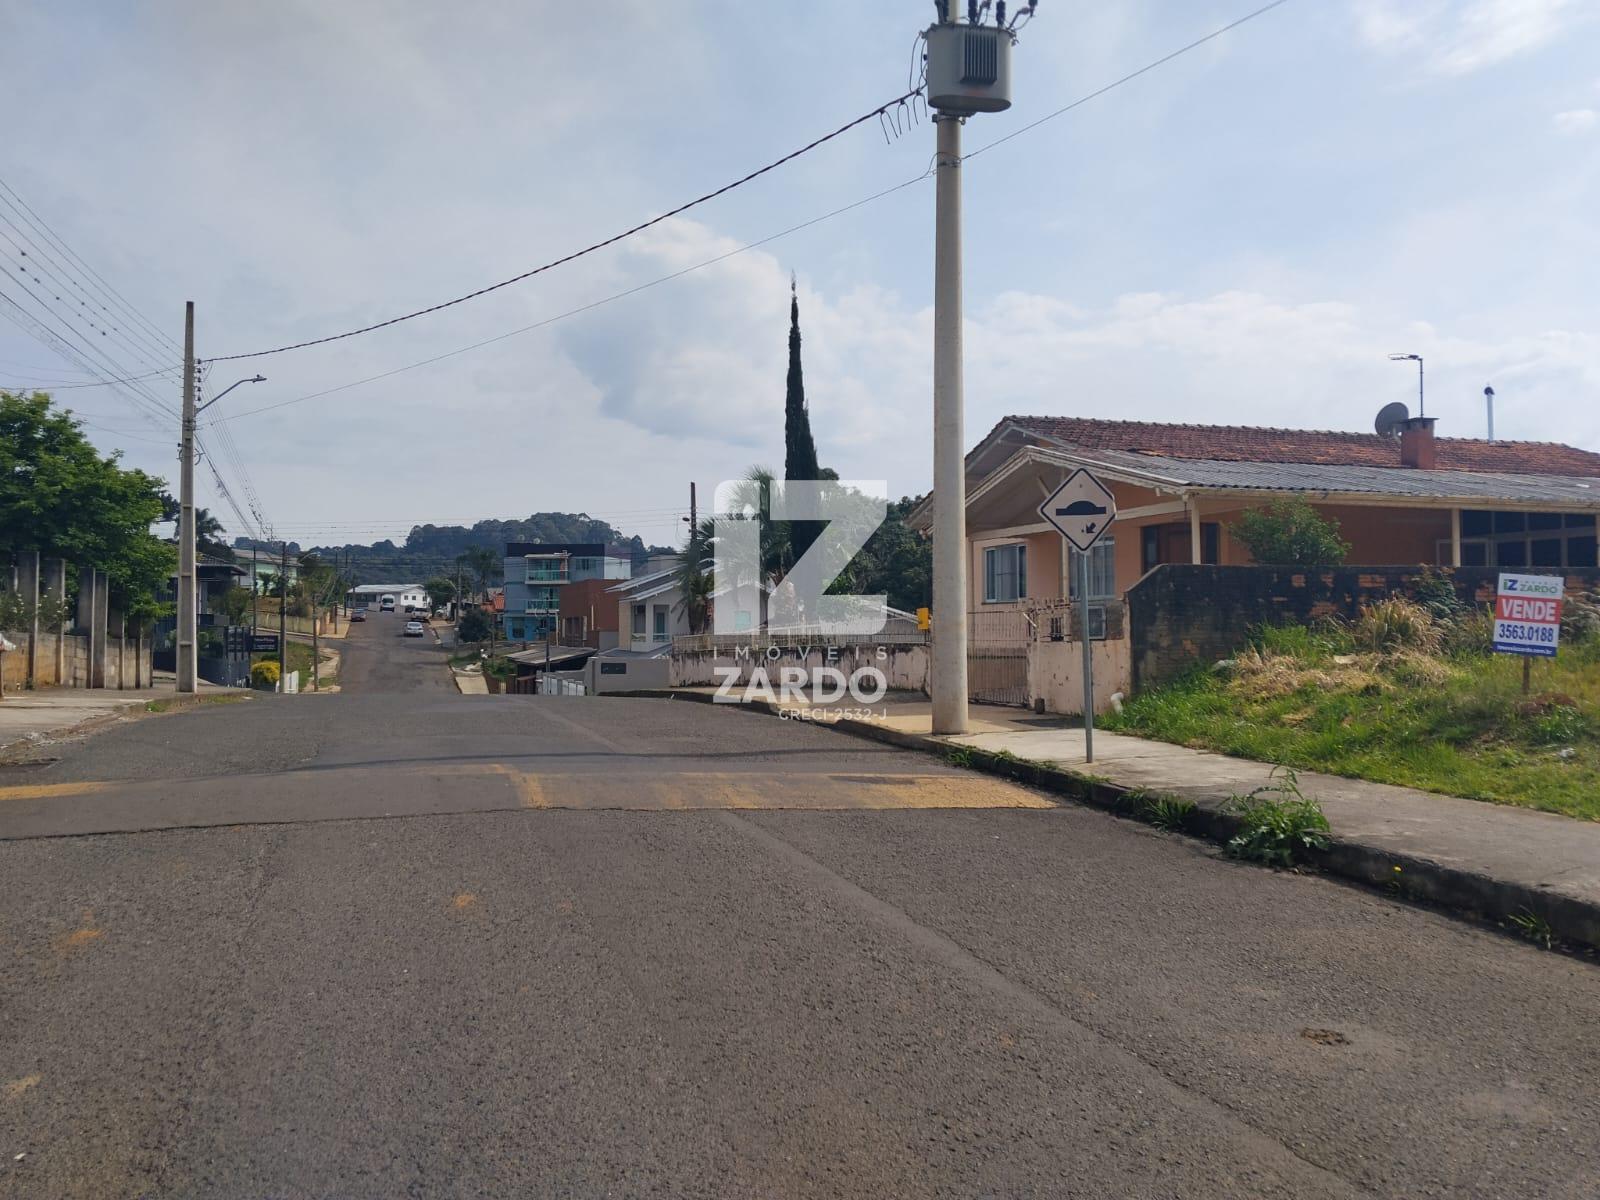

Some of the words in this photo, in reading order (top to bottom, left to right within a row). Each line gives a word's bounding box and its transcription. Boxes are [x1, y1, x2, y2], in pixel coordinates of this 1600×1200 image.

[1520, 584, 1558, 593] ZARDO
[1502, 598, 1557, 621] VENDE
[1499, 623, 1554, 642] 3563.0188
